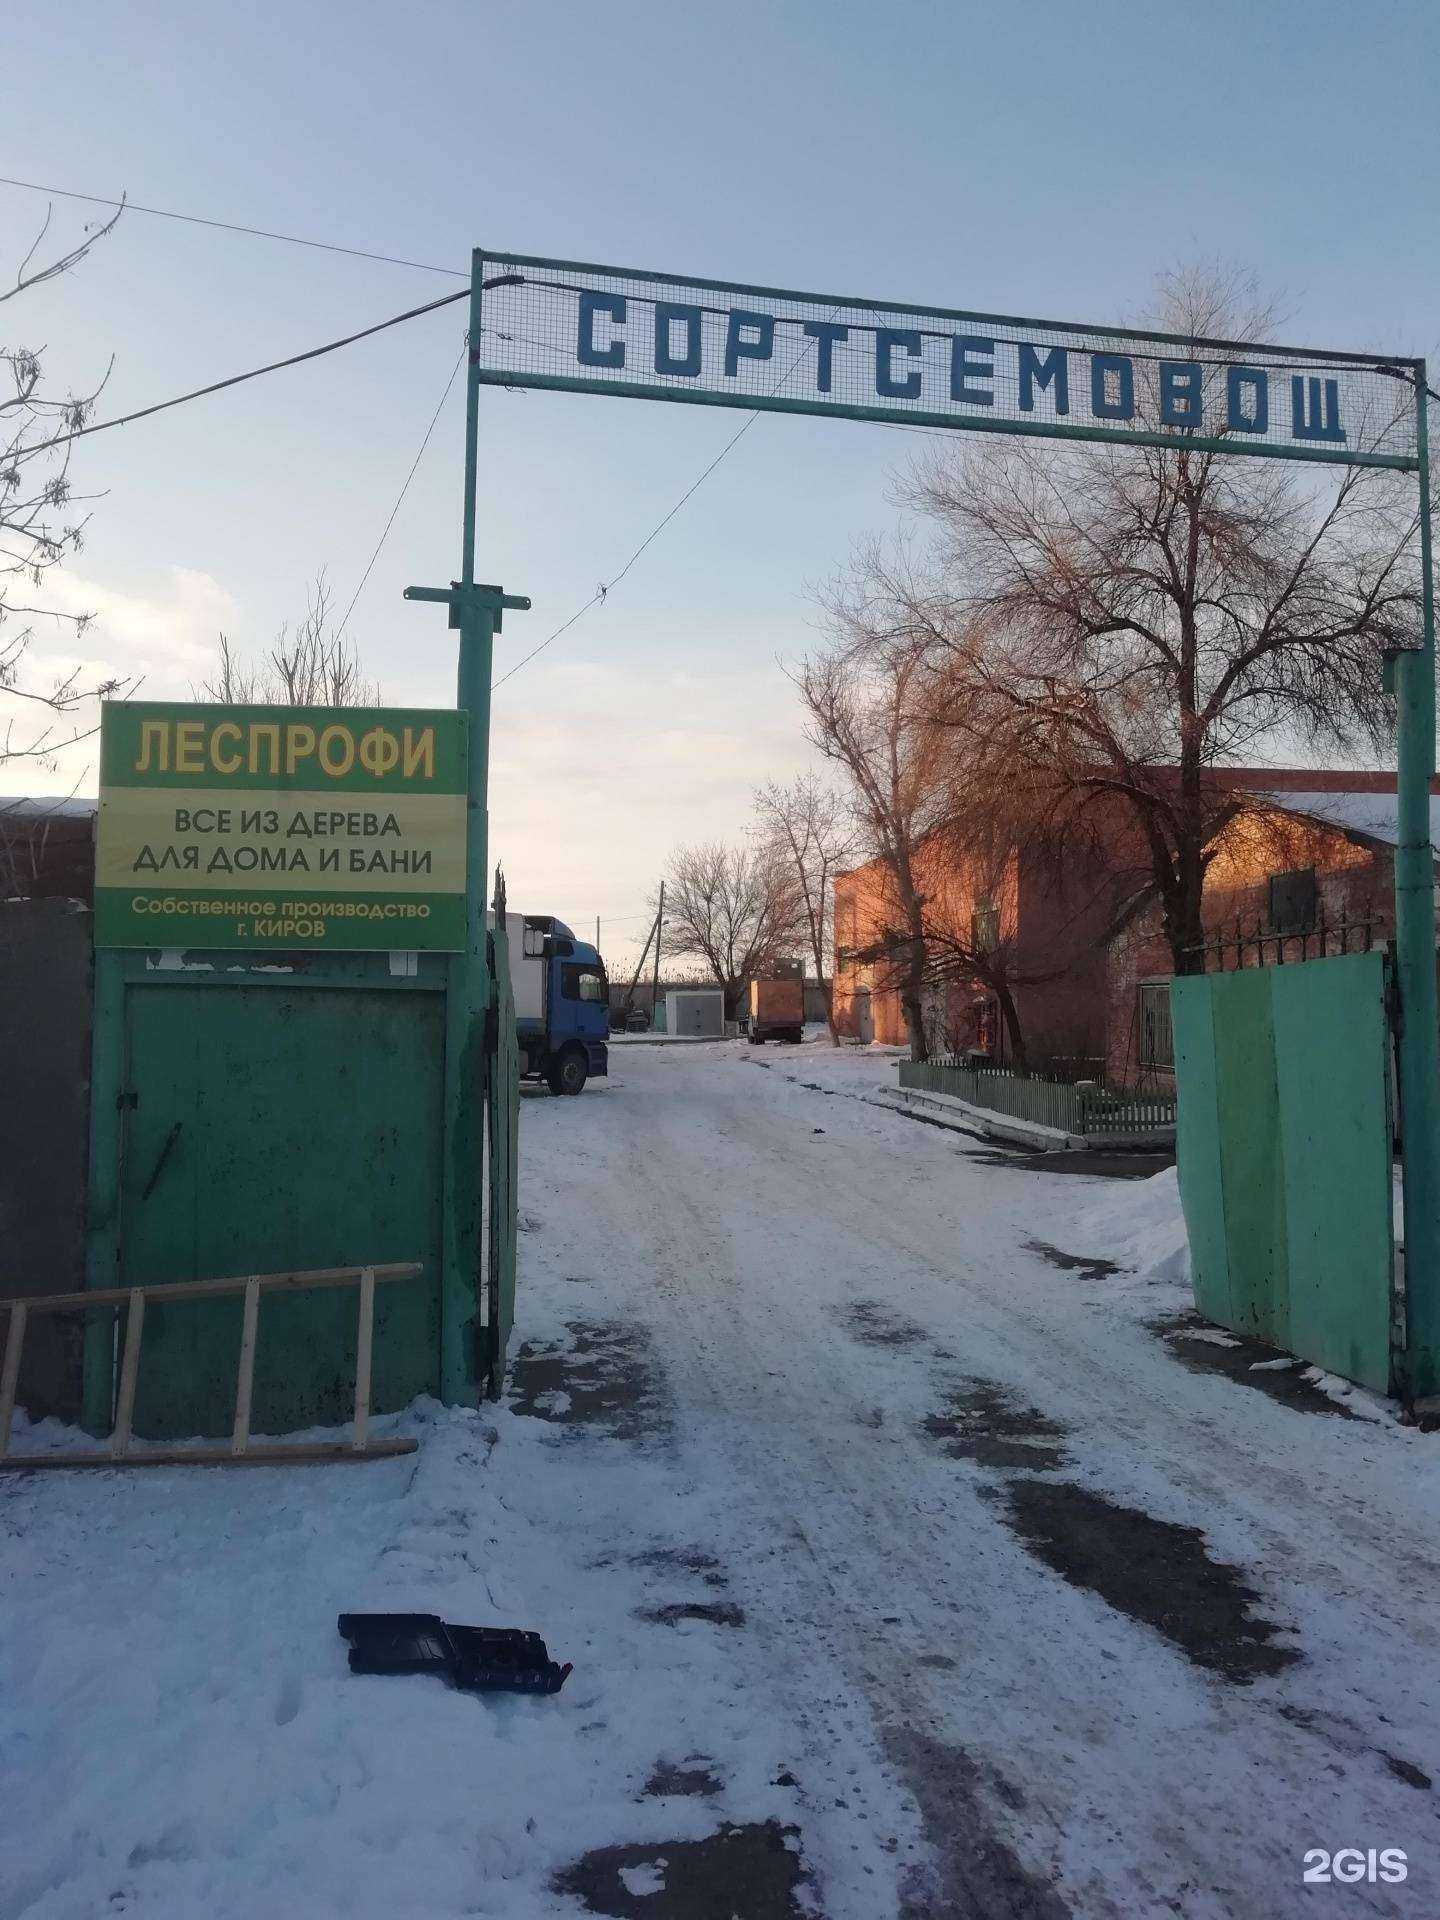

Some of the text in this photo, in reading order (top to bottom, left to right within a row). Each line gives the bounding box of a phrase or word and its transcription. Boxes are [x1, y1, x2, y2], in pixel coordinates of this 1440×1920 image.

[578, 291, 1347, 442] СОРТСЕМОВОЩ
[135, 720, 436, 778] ЛЕСПРОФИ
[174, 808, 401, 838] ВСЕ ИЗ ДЕРЕВА
[133, 845, 432, 874] ДЛЯ ДОМА И БАНИ
[131, 896, 430, 920] Собственное производство
[237, 919, 326, 938] г. КИРОВ
